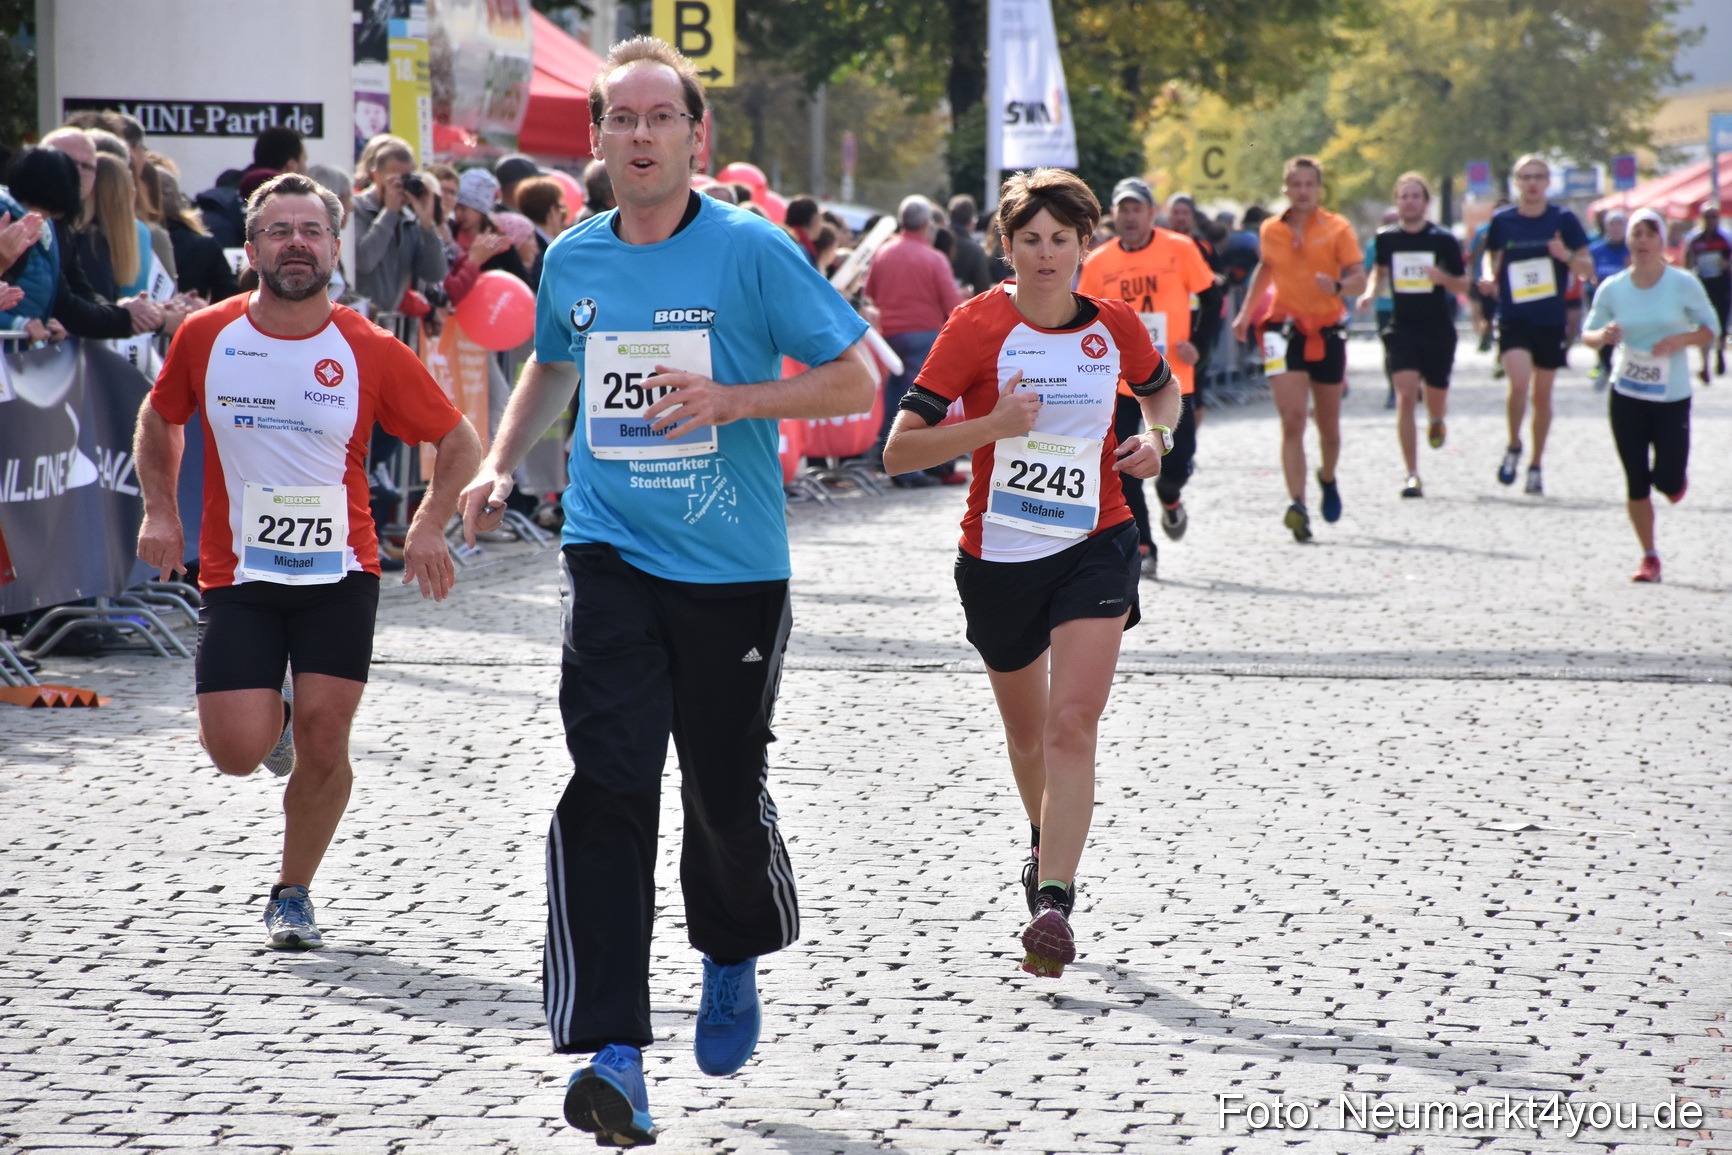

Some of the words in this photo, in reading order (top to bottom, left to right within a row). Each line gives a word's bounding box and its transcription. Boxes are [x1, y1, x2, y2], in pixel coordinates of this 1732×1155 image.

[676, 1, 712, 57] B
[1203, 146, 1225, 179] C
[1120, 275, 1158, 299] RUN
[653, 308, 716, 324] BOCK
[629, 344, 671, 354] BOCK
[1077, 364, 1111, 374] KOPPE
[1625, 361, 1661, 382] 2258
[304, 390, 346, 406] KOPPE
[603, 371, 687, 410] 250
[217, 395, 251, 404] MICHAEL
[253, 397, 276, 406] KLEIN
[257, 416, 305, 426] Raiffeisenbank
[257, 423, 289, 431] Neumarkt
[1037, 442, 1076, 455] BOCK
[629, 458, 711, 473] Neumarkter
[0, 452, 68, 502] IL.ONE
[630, 474, 697, 490] Stadtlauf
[1007, 459, 1086, 499] 2243
[284, 495, 321, 505] BOCK
[695, 489, 718, 518] September
[715, 477, 728, 491] 2017
[1021, 501, 1065, 519] Stefanie
[257, 515, 333, 547] 2275
[274, 554, 314, 568] Michael
